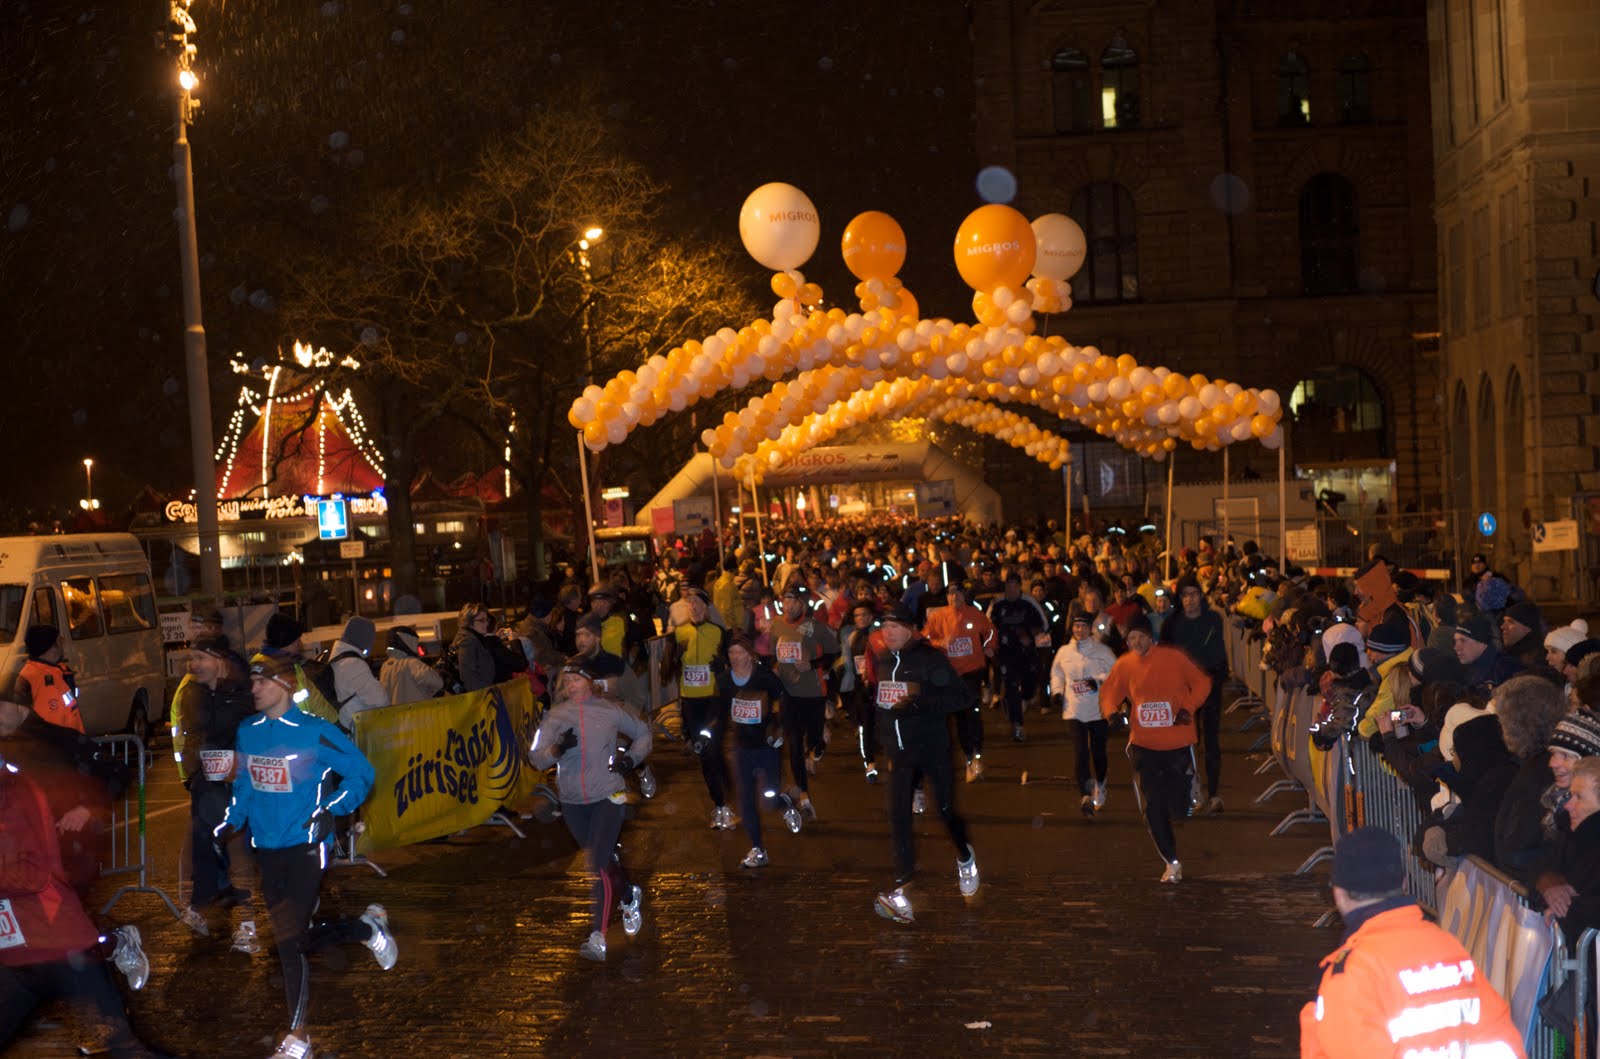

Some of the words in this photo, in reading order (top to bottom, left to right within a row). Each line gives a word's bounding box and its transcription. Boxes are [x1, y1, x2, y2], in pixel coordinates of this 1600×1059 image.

[769, 210, 817, 223] MIGROS
[967, 240, 1020, 256] MIGROS
[685, 672, 706, 681] 4391
[735, 707, 757, 716] 9798
[1142, 709, 1167, 721] 9715
[252, 756, 284, 766] MIGROS
[253, 767, 283, 784] 7387
[394, 751, 479, 818] zürisee
